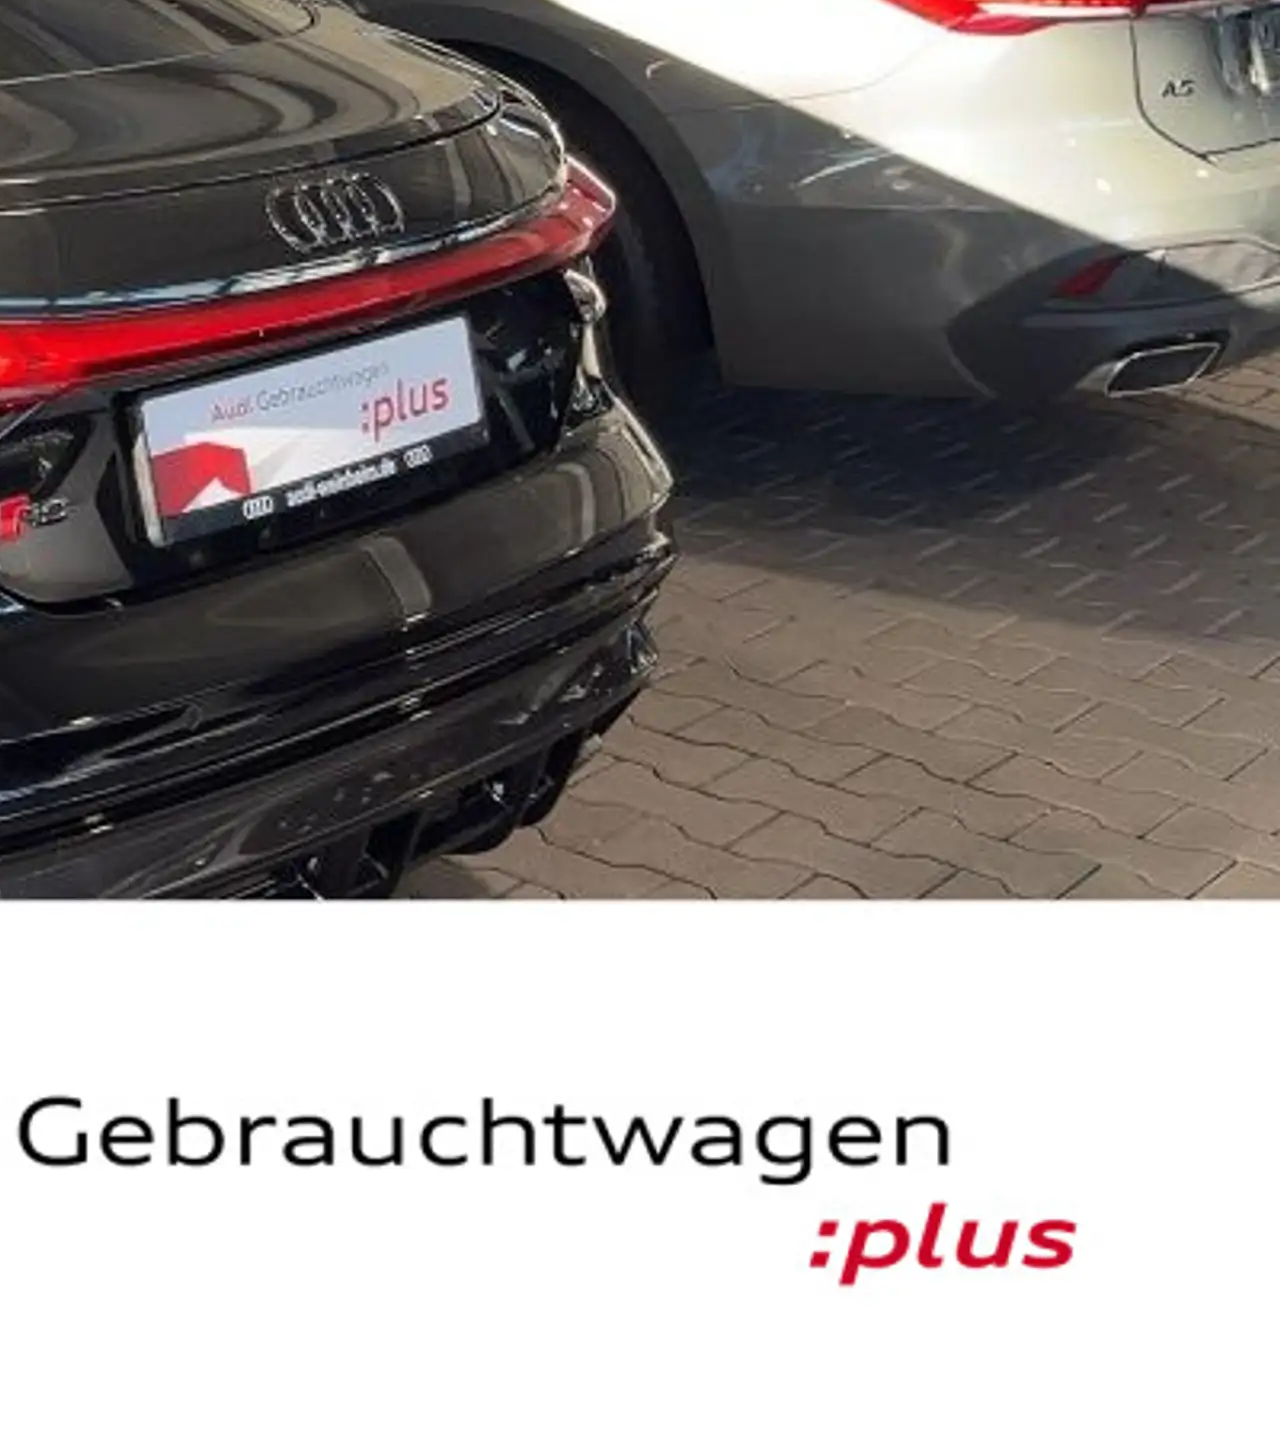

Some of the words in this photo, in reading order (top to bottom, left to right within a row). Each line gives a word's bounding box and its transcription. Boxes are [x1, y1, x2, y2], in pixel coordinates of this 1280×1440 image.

[1161, 79, 1196, 98] A5
[209, 400, 252, 423] Audi
[254, 360, 391, 412] Gebrauchtwagen
[359, 375, 450, 443] :plus
